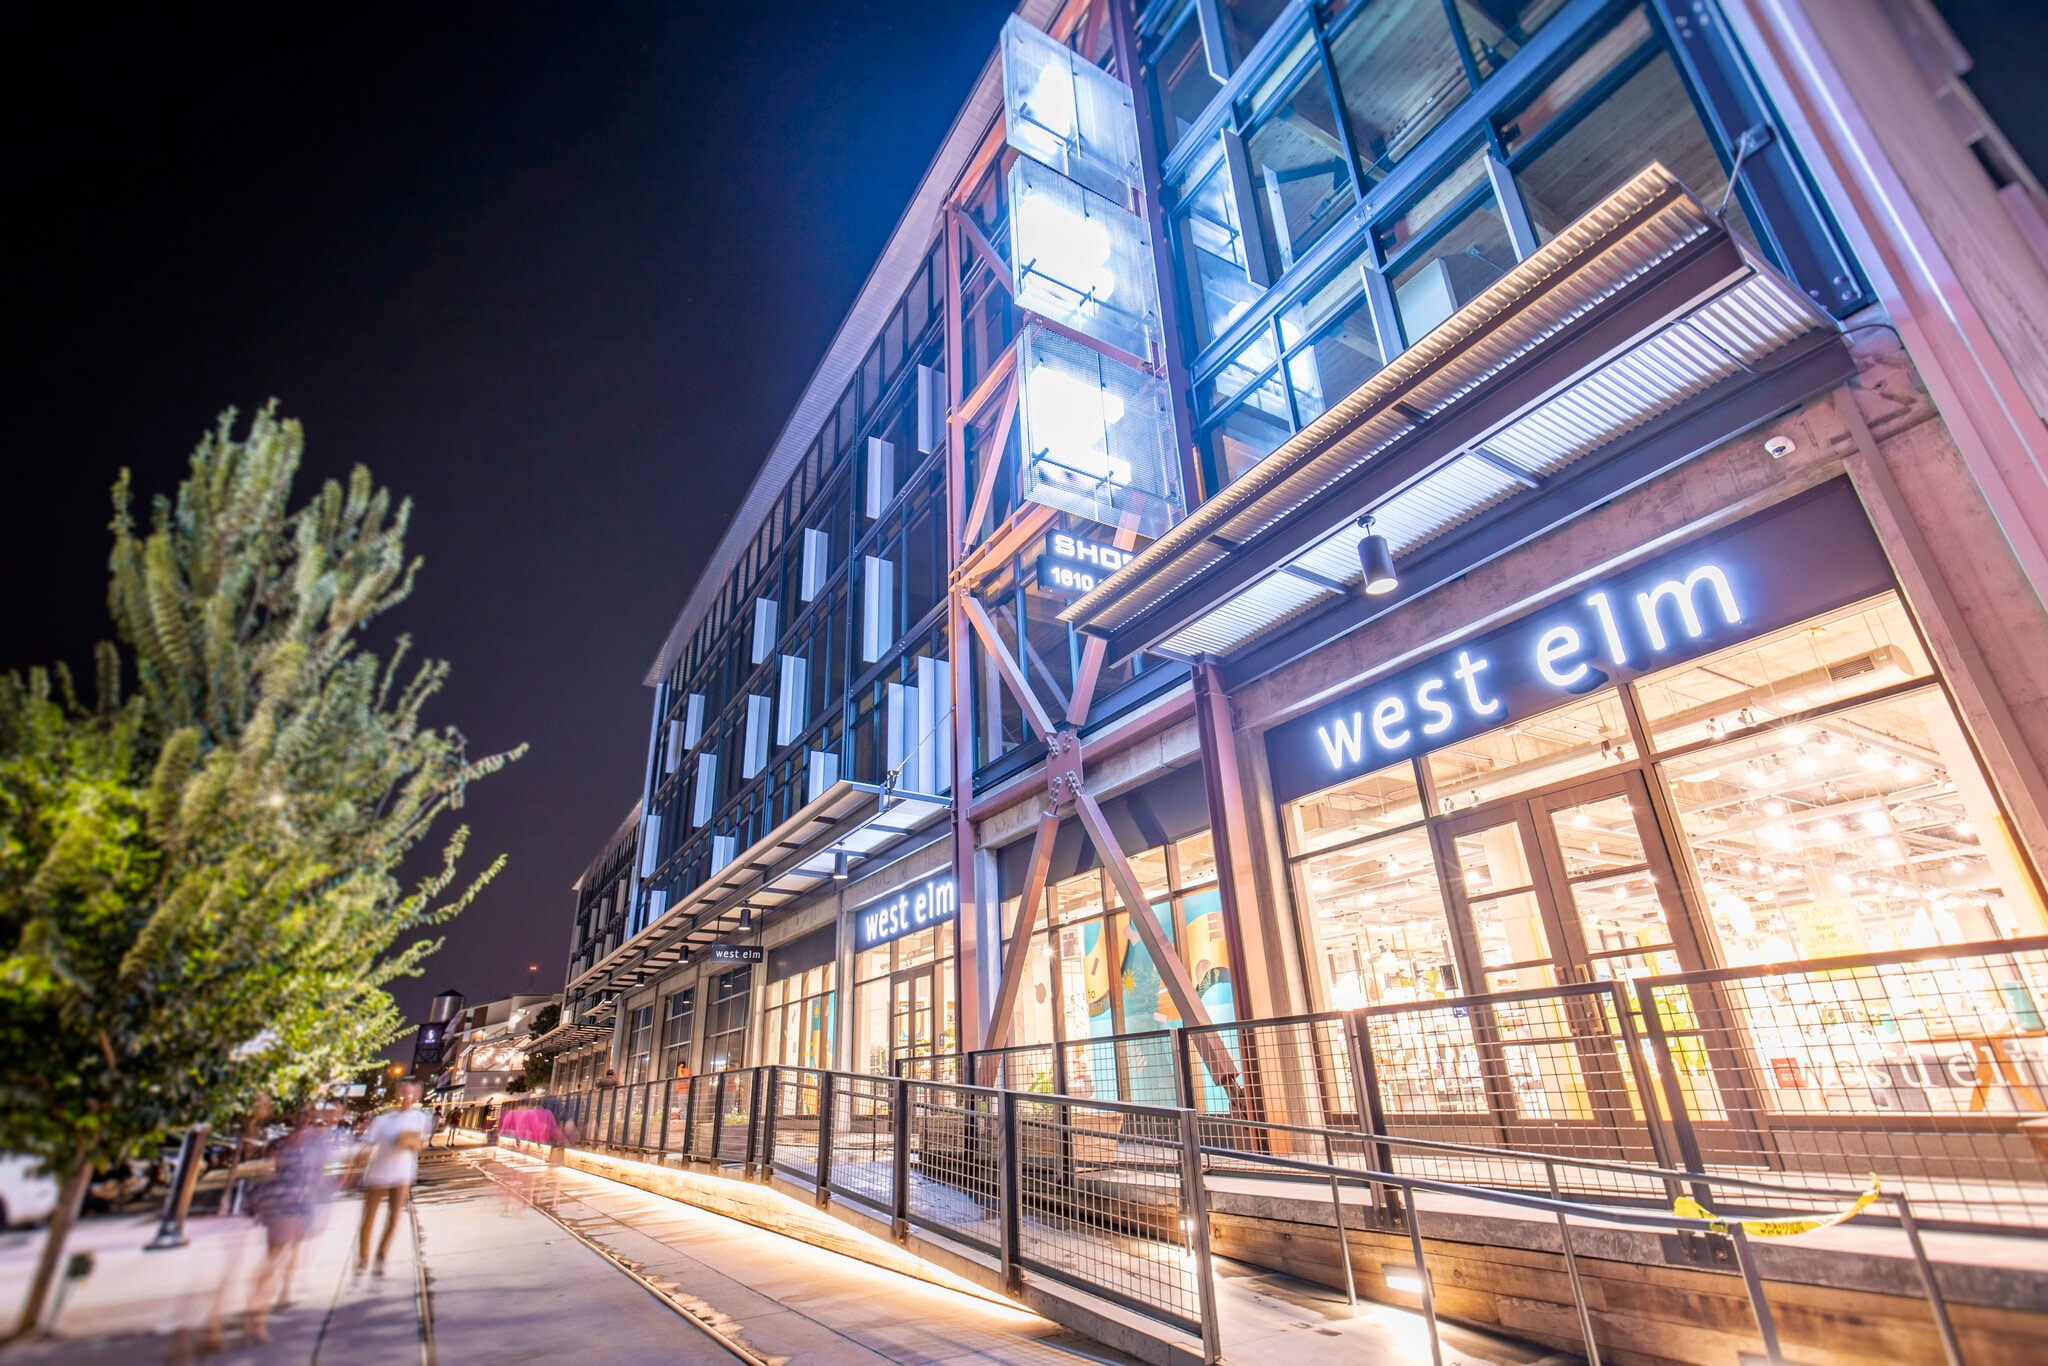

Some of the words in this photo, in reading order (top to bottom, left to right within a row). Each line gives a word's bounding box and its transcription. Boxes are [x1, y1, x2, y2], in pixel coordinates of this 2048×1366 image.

[1055, 534, 1134, 570] SHO
[1317, 651, 1499, 770] west
[1536, 563, 1742, 687] elm
[866, 894, 909, 942] west
[915, 882, 954, 924] elm
[715, 949, 740, 959] west
[742, 950, 761, 959] elm
